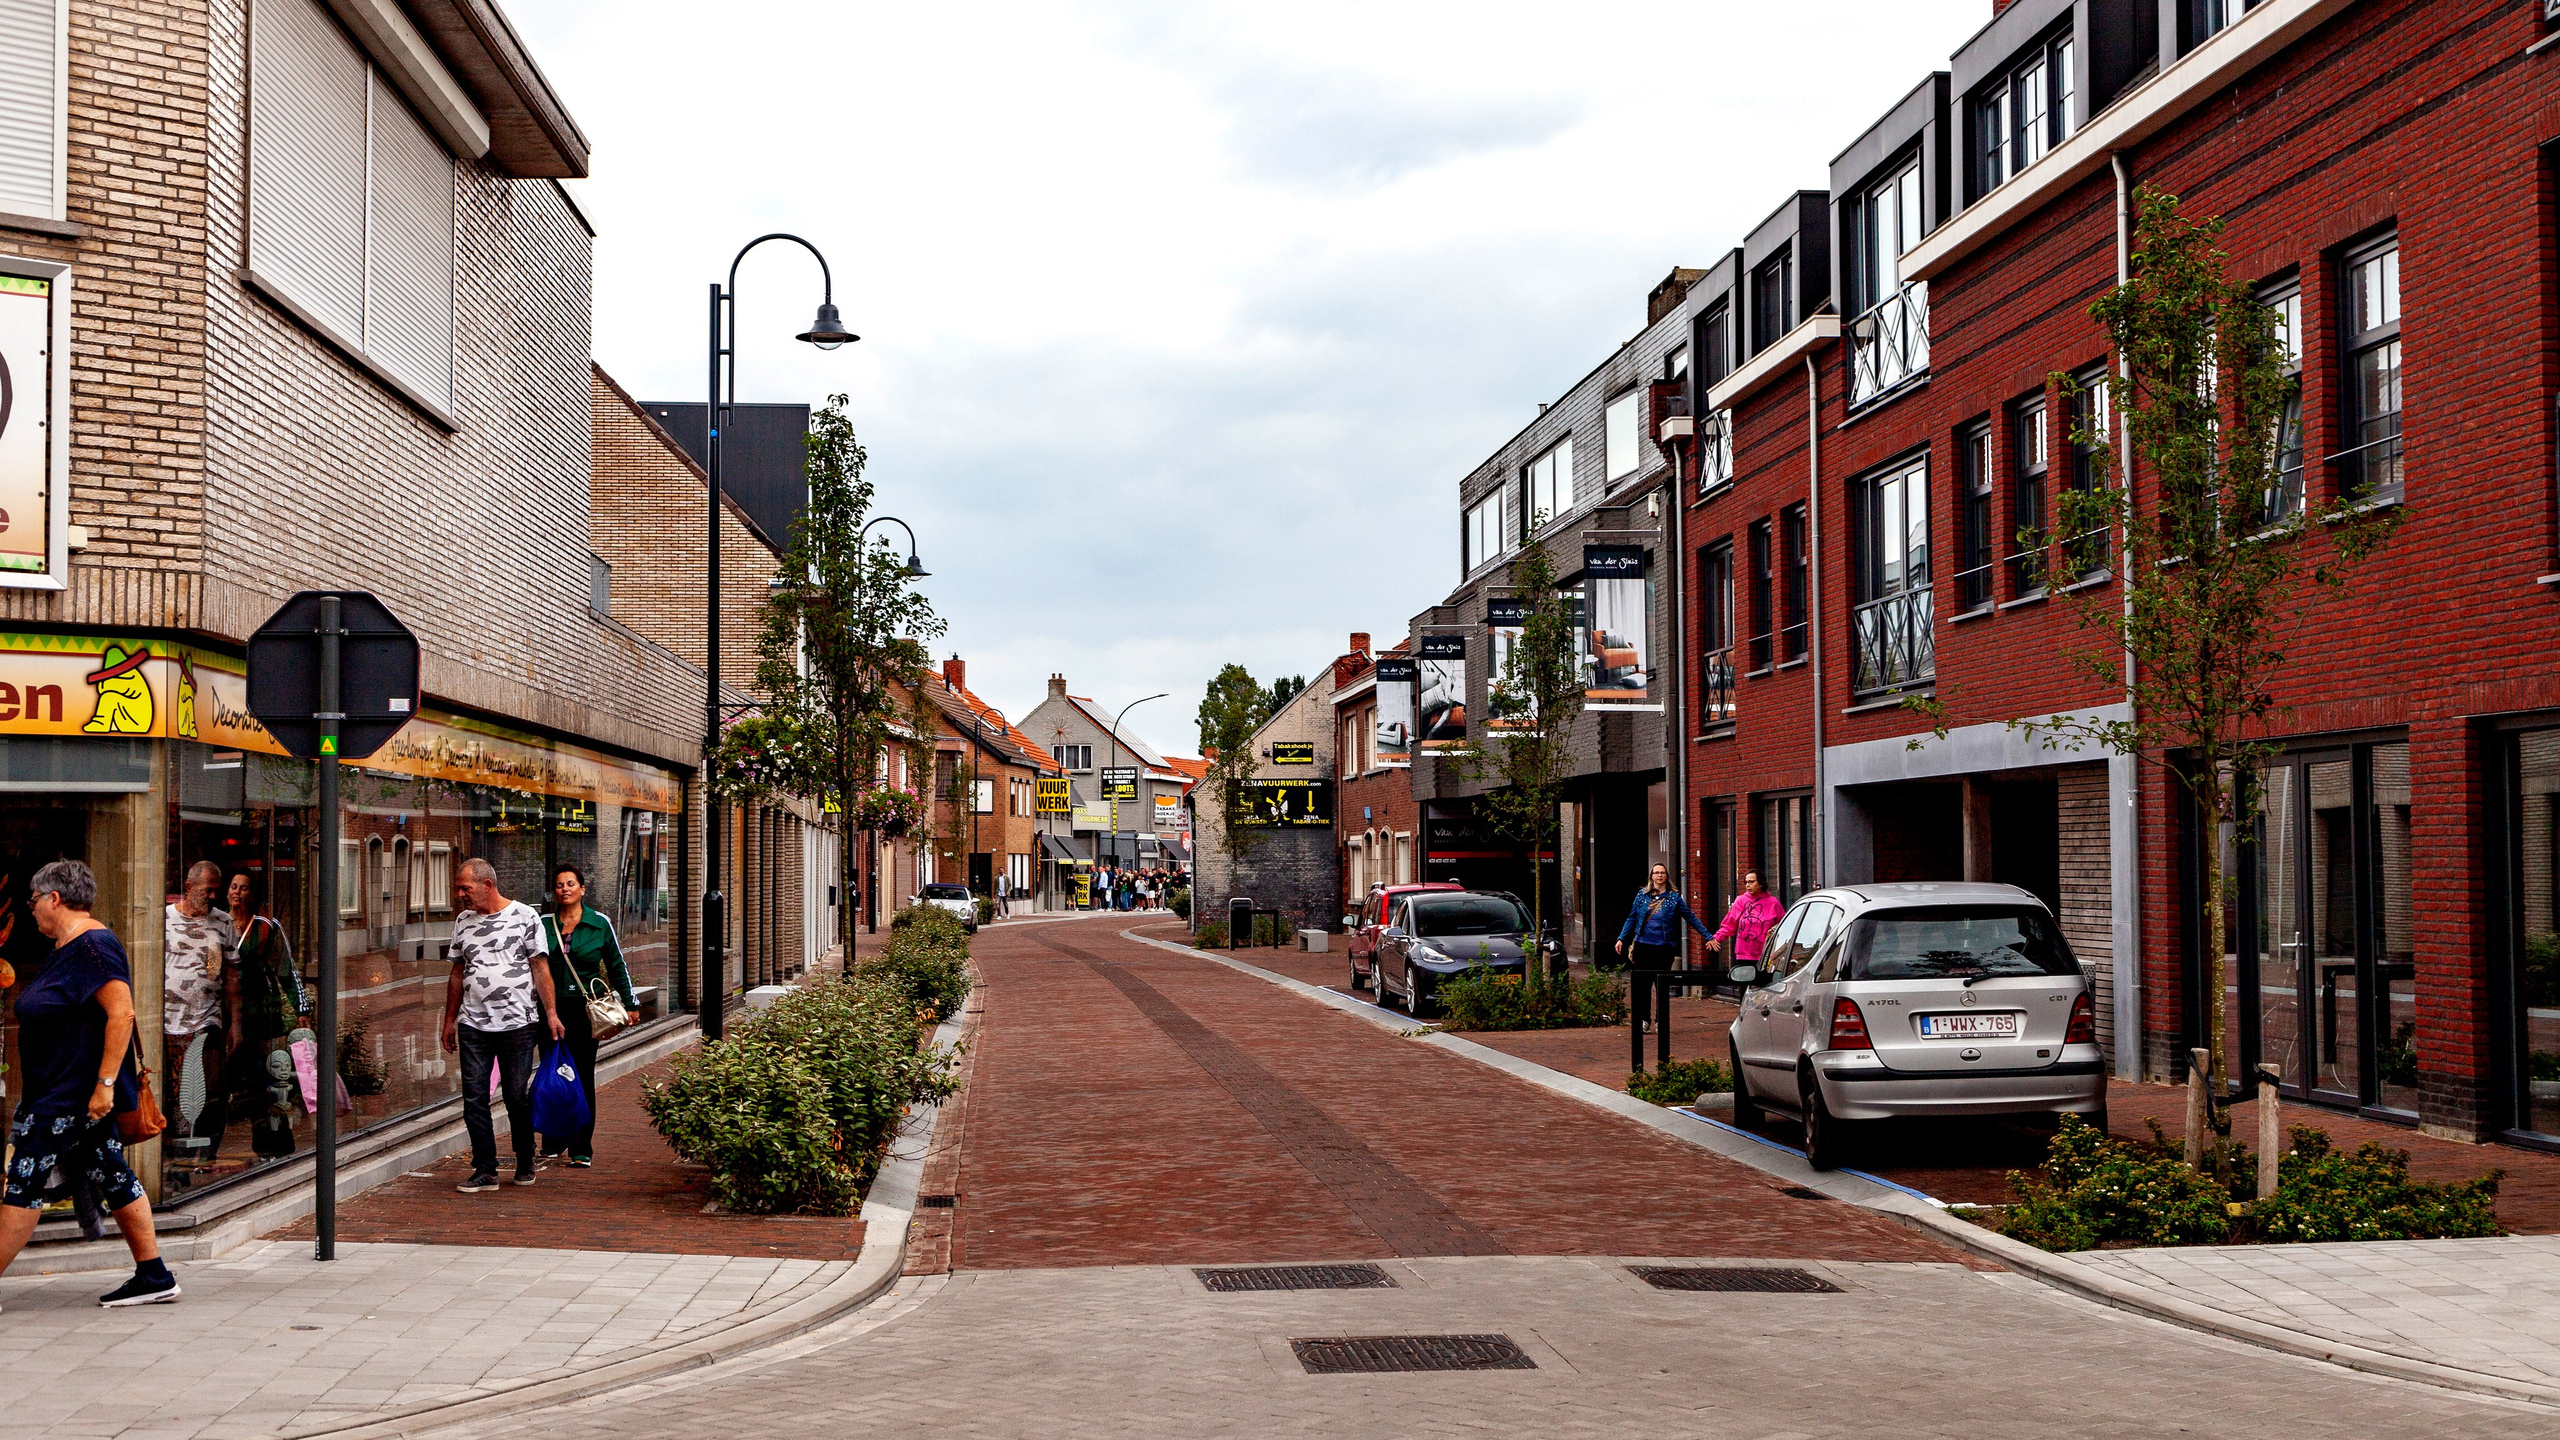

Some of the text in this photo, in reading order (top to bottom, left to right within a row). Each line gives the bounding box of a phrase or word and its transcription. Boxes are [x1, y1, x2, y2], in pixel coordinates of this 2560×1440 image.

[1038, 780, 1068, 794] VUUR
[1114, 784, 1135, 792] LOOTS
[1037, 796, 1069, 810] WERK
[1923, 1026, 1930, 1034] B
[1933, 1016, 2013, 1031] 1-WWX-765
